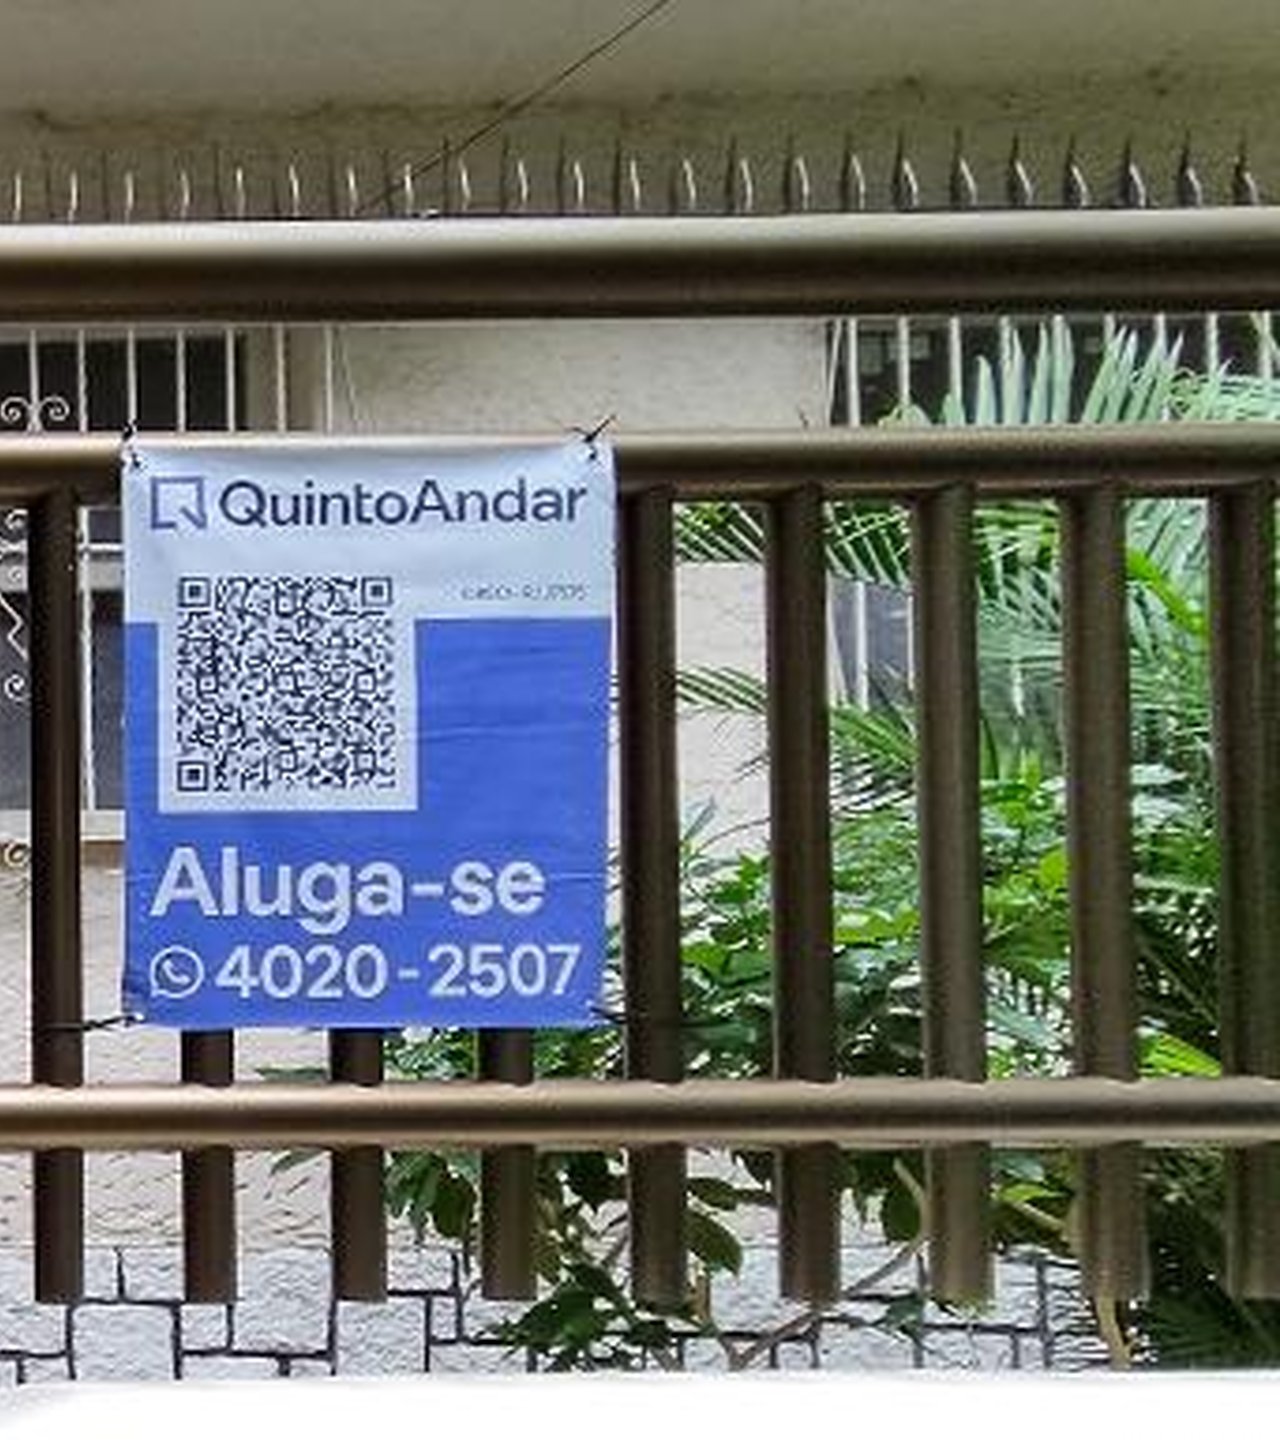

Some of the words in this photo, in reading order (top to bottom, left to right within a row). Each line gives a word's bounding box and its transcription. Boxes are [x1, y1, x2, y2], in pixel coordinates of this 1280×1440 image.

[219, 476, 588, 528] QuintoAndar
[150, 846, 545, 935] Aluga-se
[214, 944, 582, 999] 4020-2507
